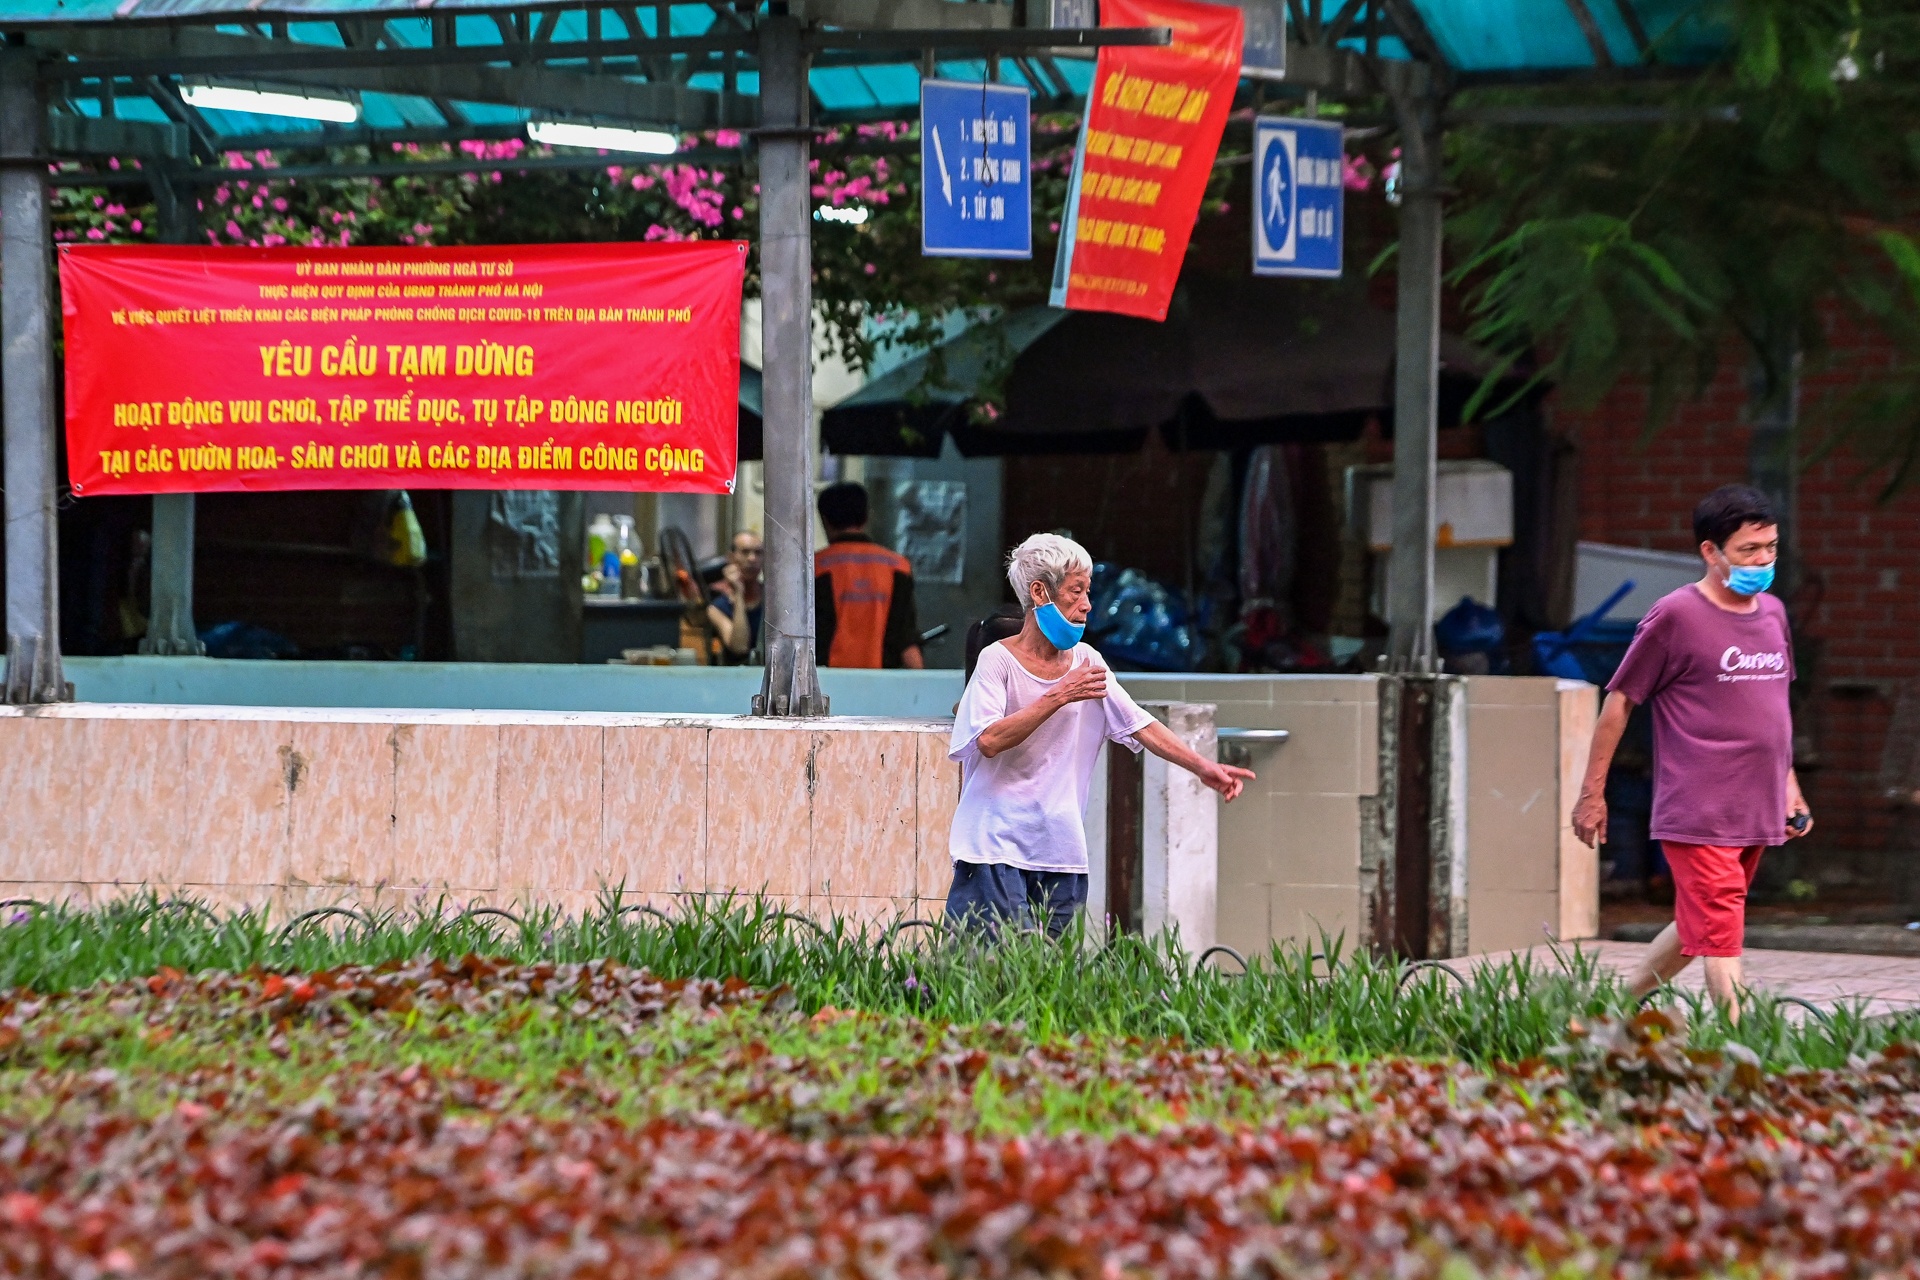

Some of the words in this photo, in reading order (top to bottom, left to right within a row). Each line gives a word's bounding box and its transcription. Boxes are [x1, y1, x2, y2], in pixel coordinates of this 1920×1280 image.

[961, 156, 970, 182] 2.
[961, 195, 971, 220] 3.
[314, 262, 338, 276] BAN
[342, 261, 374, 276] NHÂN
[404, 260, 450, 277] PHƯỜNG
[482, 261, 496, 277] TƯ
[292, 283, 319, 300] HIỆN
[321, 285, 344, 299] QUY
[347, 285, 375, 299] ĐỊNH
[378, 282, 400, 298] CỦA
[403, 285, 435, 298] UBND
[439, 283, 475, 298] THÀNH
[504, 283, 519, 297] HÀ
[523, 282, 543, 299] NỘI
[156, 307, 191, 324] QUYẾT
[193, 307, 217, 325] LIỆT
[255, 309, 283, 322] KHAI
[285, 308, 309, 322] CÁC
[311, 307, 339, 323] BIỆN
[341, 307, 373, 321] PHÁP
[374, 307, 414, 321] PHÒNG
[416, 305, 456, 321] CHỐNG
[459, 308, 486, 323] DỊCH
[489, 308, 541, 321] COVID-19
[544, 306, 574, 322] TRÊN
[576, 308, 596, 323] ĐỊA
[599, 306, 624, 322] BÀN
[627, 307, 665, 322] THÀNH
[260, 340, 312, 376] YÊU
[321, 336, 377, 376] CẦU
[387, 345, 446, 382] TẠM
[456, 339, 534, 376] DỪNG
[114, 402, 163, 430] HOẠT
[168, 397, 223, 429] ĐỘNG
[229, 400, 262, 423] VUI
[268, 397, 322, 424] CHƠI,
[329, 395, 368, 426] TẬP
[374, 390, 413, 421] THỂ
[418, 399, 465, 426] DỤC,
[473, 399, 498, 427] TỤ
[504, 395, 544, 427] TẬP
[550, 395, 608, 423] ĐÔNG
[616, 396, 681, 425] NGƯỜI
[99, 450, 130, 478] TẠI
[135, 445, 172, 472] CÁC
[178, 442, 231, 471] VƯỜN
[291, 441, 334, 468] SÂN
[340, 443, 388, 468] CHƠI
[395, 441, 421, 468] VÀ
[428, 441, 470, 468] CÁC
[476, 446, 511, 474] ĐỊA
[518, 437, 572, 469] ĐIỂM
[580, 442, 637, 470] CÔNG
[645, 444, 704, 476] CỘNG
[1720, 645, 1784, 672] Curves
